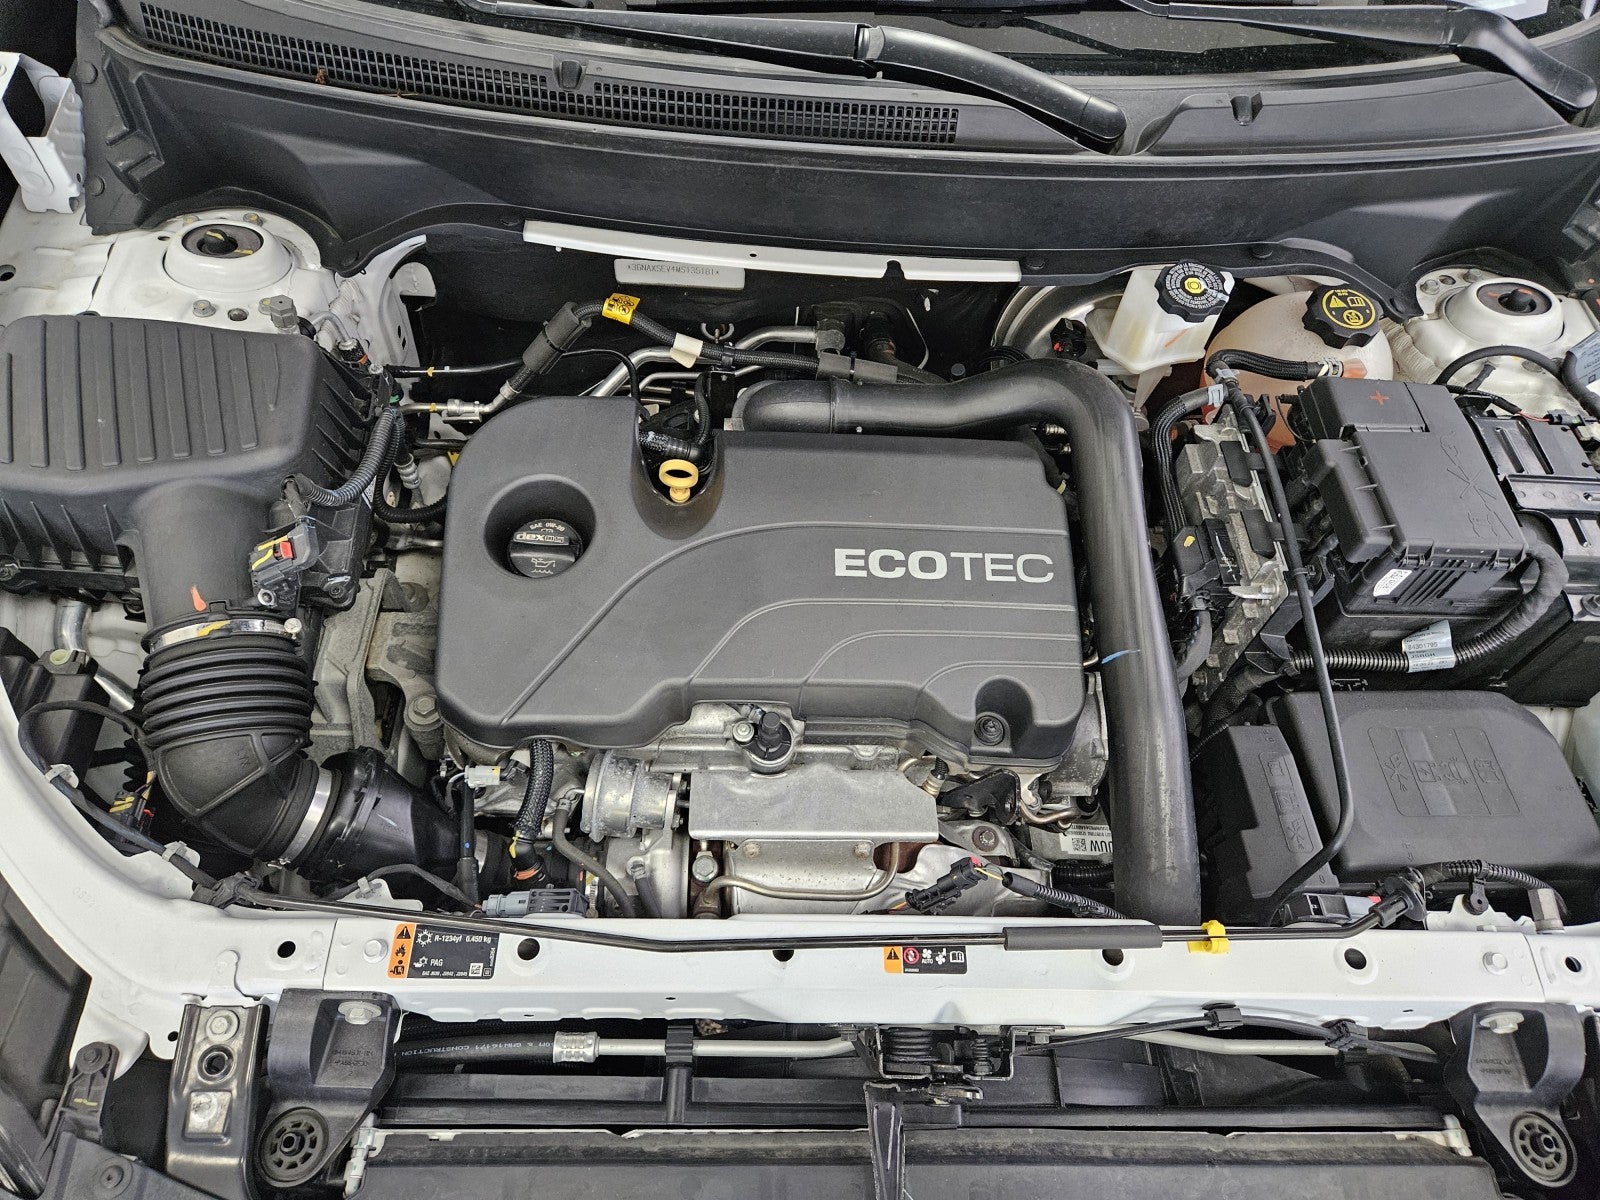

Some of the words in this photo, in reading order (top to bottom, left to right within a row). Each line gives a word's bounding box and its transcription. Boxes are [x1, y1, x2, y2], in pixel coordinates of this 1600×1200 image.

[529, 522, 543, 530] SAE
[834, 548, 1054, 583] ECOTEC
[434, 935, 462, 944] R-1234yf
[483, 936, 492, 944] kg
[430, 958, 444, 967] PAG
[401, 1045, 470, 1057] CONSTRUCTION
